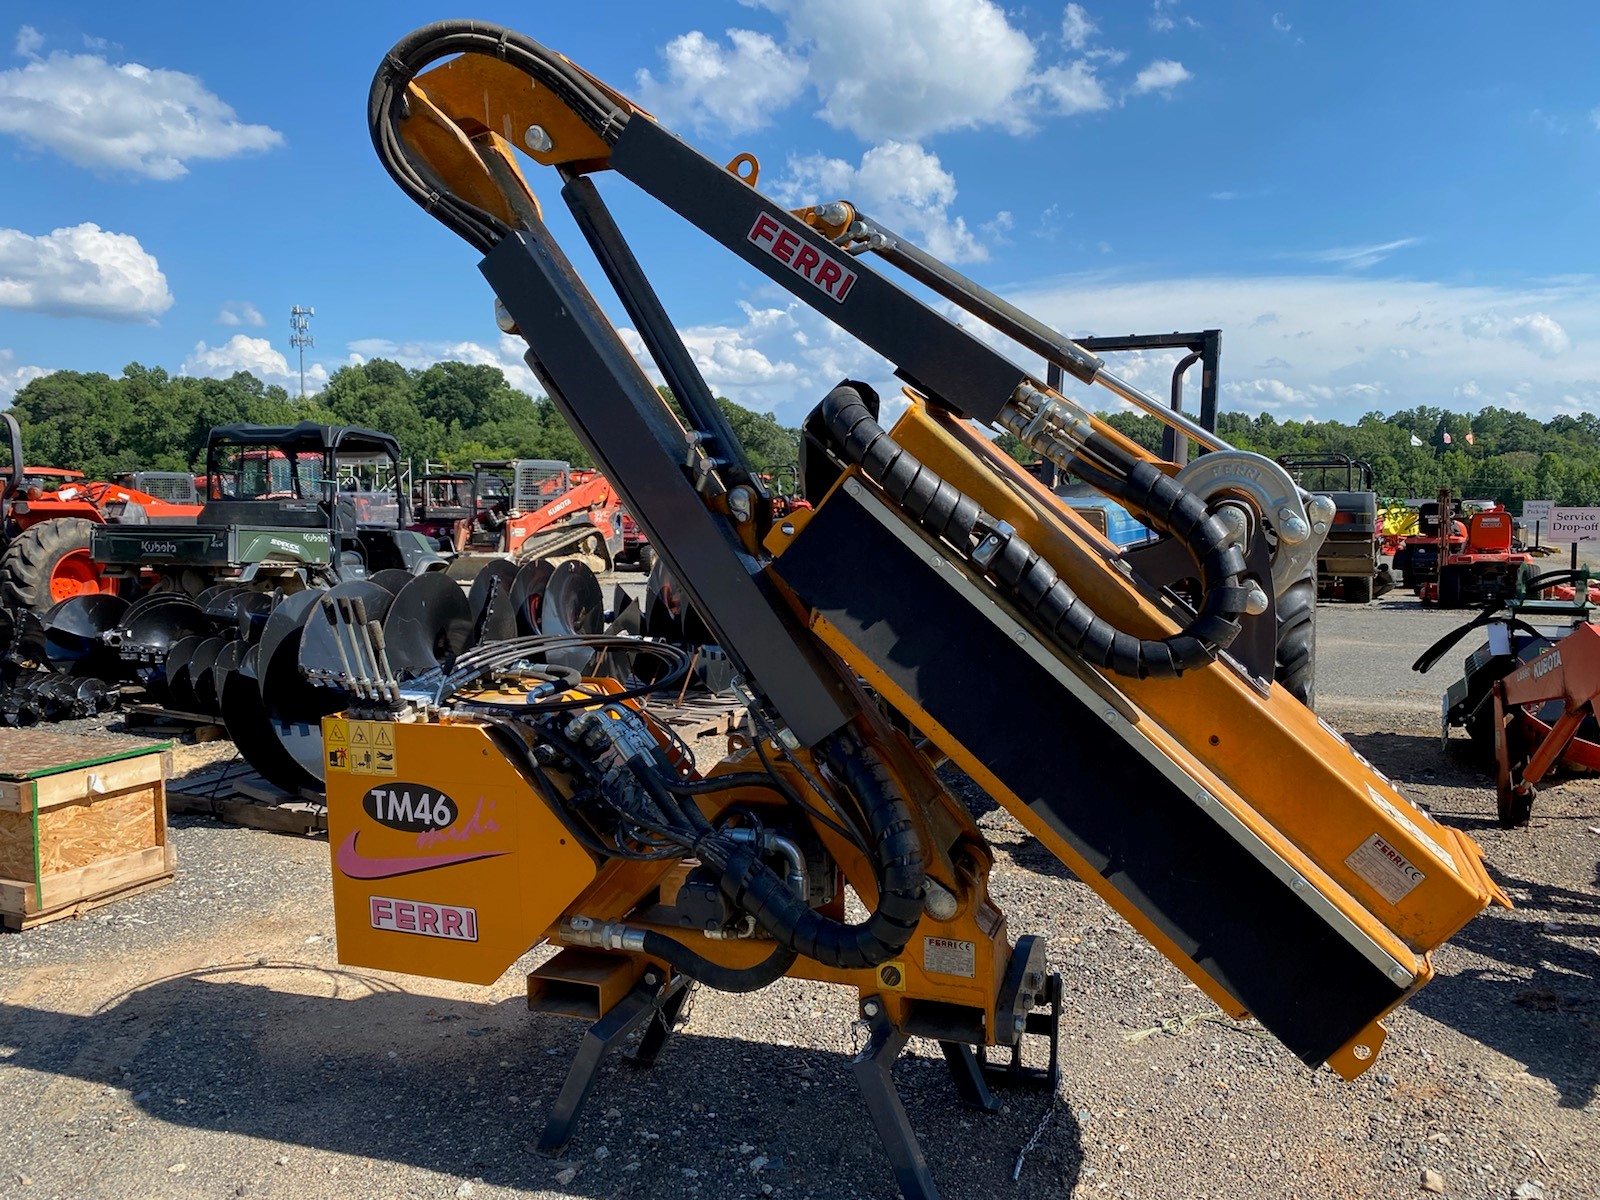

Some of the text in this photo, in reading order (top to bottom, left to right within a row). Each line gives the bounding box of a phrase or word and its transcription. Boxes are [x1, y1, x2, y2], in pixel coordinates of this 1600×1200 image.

[751, 215, 855, 299] FERRI
[1212, 464, 1262, 480] FERRI
[547, 499, 572, 517] KUBOTA
[1556, 512, 1596, 521] Service
[1553, 522, 1598, 533] Drop-off
[303, 533, 328, 543] Kubota
[141, 541, 177, 553] Kubota
[1533, 650, 1562, 679] KUBOTA
[371, 789, 452, 827] TM46
[1373, 838, 1406, 869] FERRI
[372, 899, 476, 938] FERRI
[929, 938, 957, 949] FERRI
